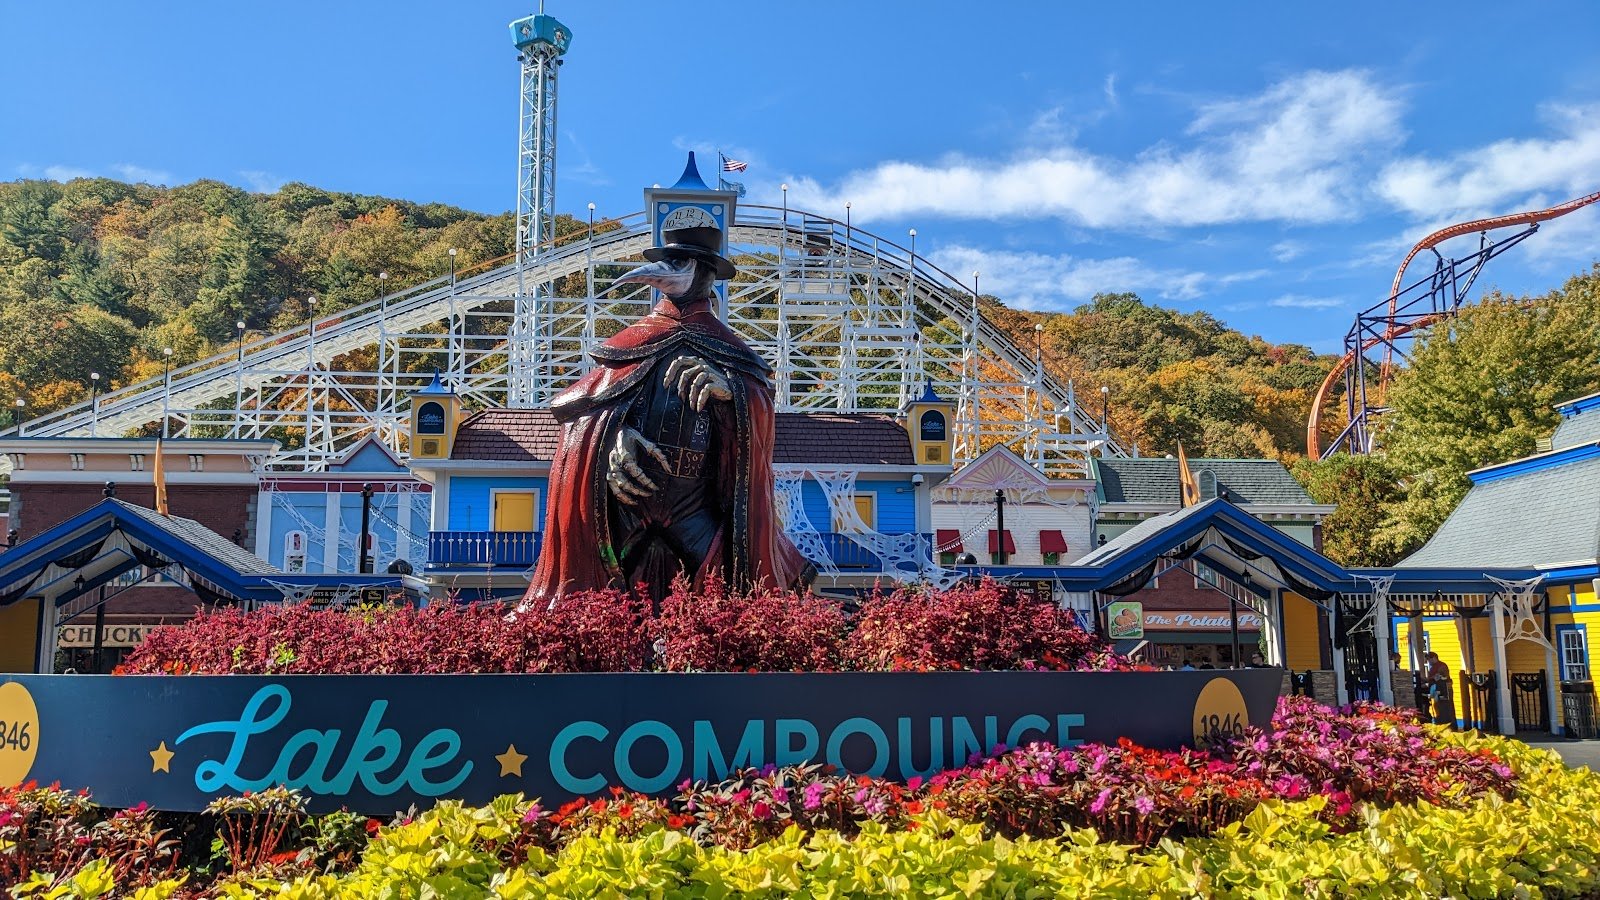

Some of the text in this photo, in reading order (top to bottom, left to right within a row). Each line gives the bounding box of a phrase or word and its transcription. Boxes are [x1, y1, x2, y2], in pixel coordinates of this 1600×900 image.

[675, 211, 682, 219] 11
[686, 209, 695, 218] 12
[666, 219, 675, 227] 10
[1145, 615, 1172, 625] The
[1174, 613, 1232, 627] Potato
[62, 627, 152, 643] CHUCK
[1298, 675, 1304, 683] 2
[1476, 674, 1481, 683] 1
[1201, 712, 1243, 740] 1846
[175, 684, 474, 796] Lake
